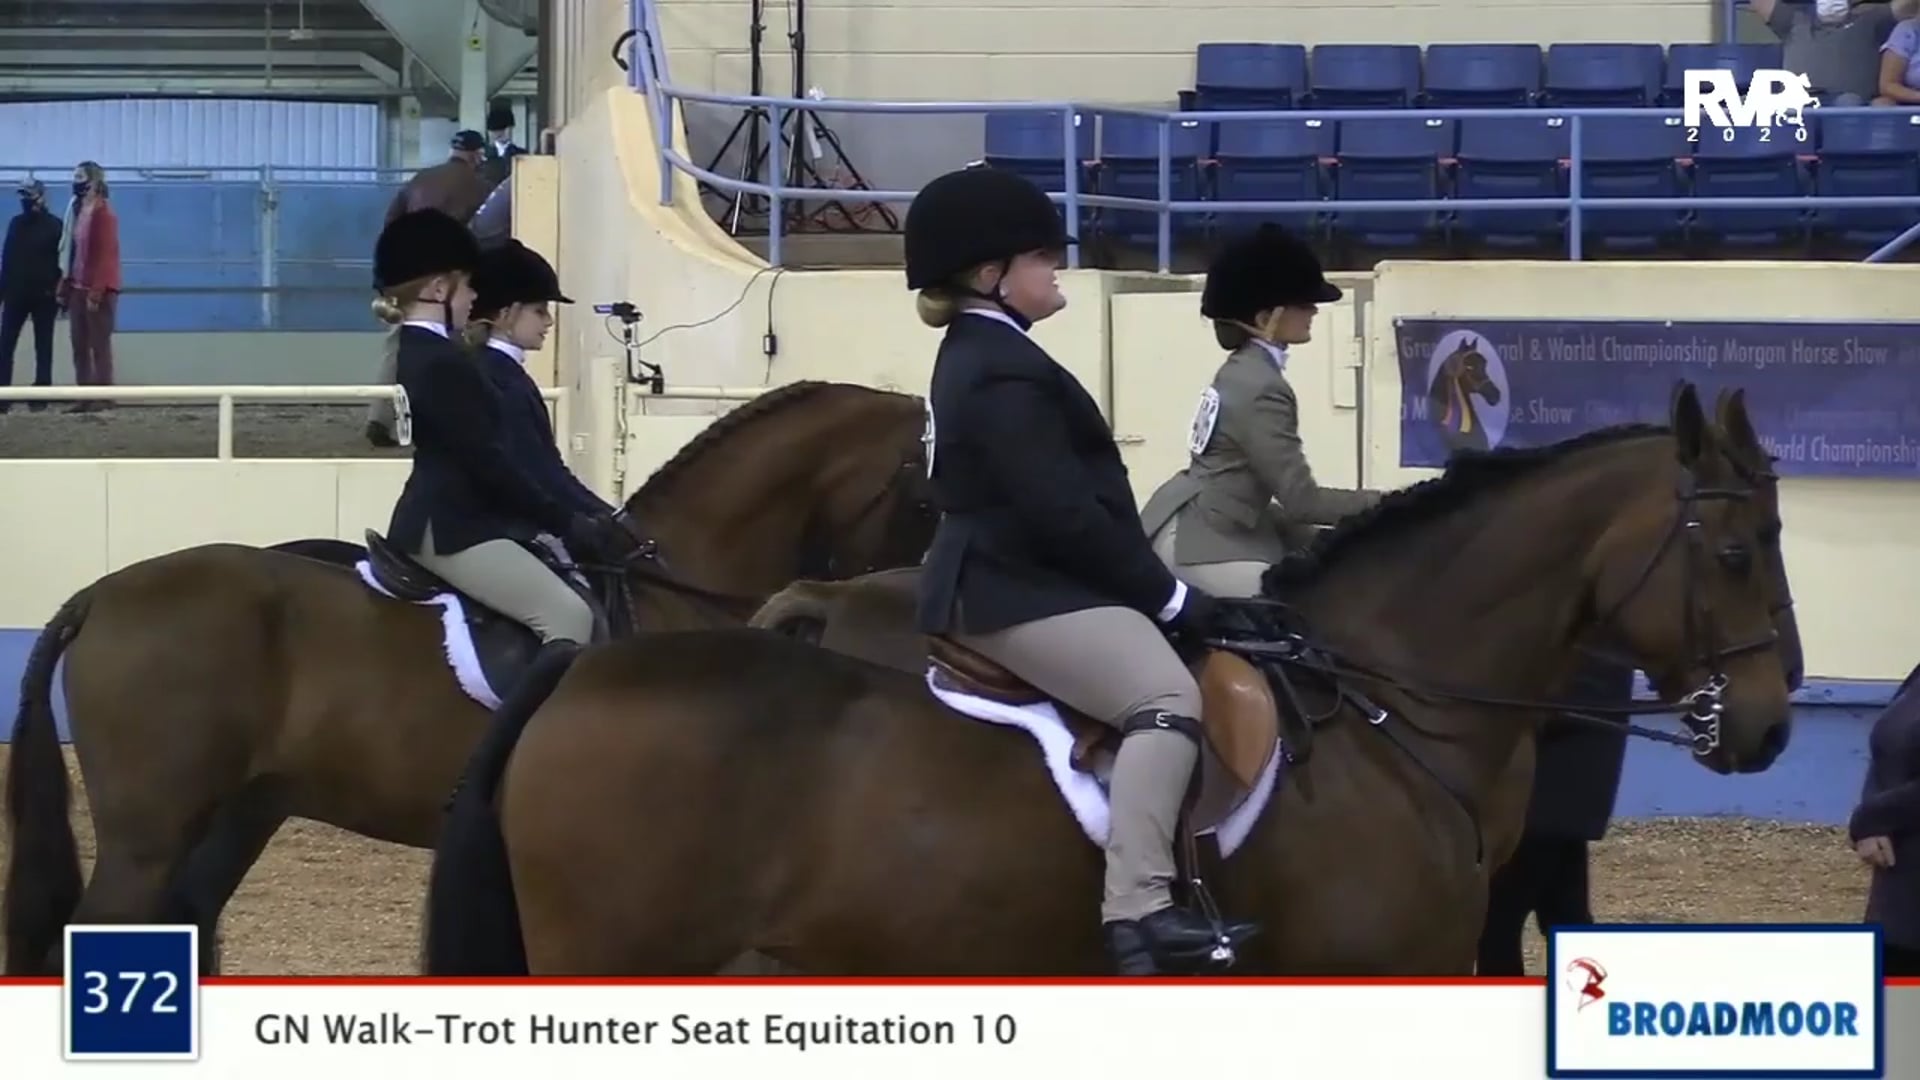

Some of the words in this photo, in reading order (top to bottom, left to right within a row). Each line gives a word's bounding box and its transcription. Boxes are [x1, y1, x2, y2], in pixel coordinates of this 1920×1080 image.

[1530, 338, 1543, 361] &
[1547, 336, 1597, 361] World
[1601, 335, 1718, 368] Championship
[1723, 338, 1786, 369] Morgan
[1792, 339, 1839, 364] Horse
[1844, 336, 1889, 365] Show
[1529, 397, 1574, 425] Show
